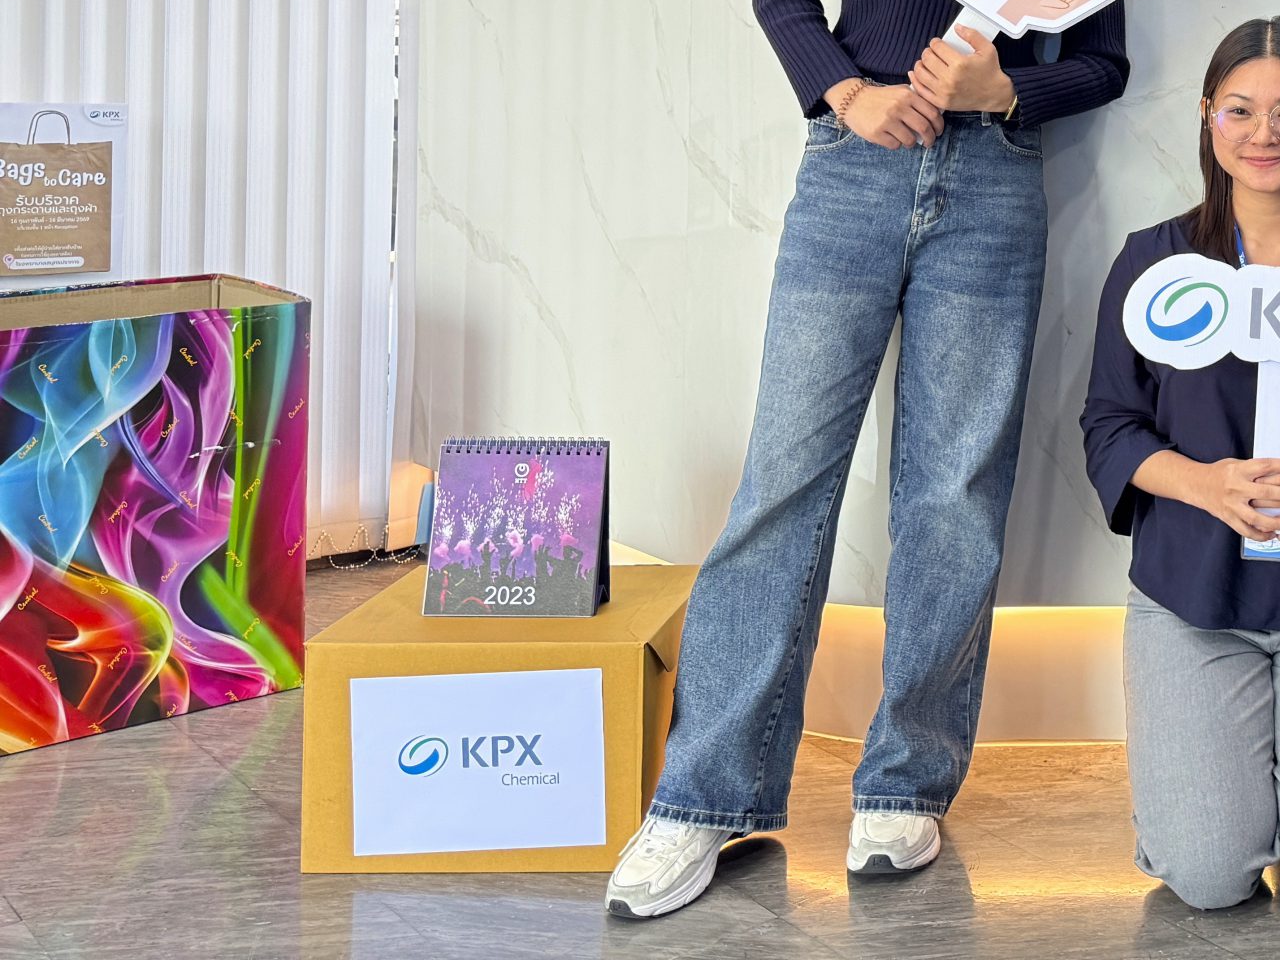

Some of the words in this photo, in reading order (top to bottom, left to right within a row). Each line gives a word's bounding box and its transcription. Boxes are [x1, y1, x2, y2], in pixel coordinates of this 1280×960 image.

[44, 176, 57, 187] to
[59, 168, 106, 187] Care
[16, 194, 79, 206] รับบริจาค
[179, 347, 198, 367] Central
[288, 398, 305, 420] Central
[287, 535, 305, 557] Central
[17, 587, 39, 611] Central
[483, 585, 536, 606] 2023
[107, 647, 128, 670] Central
[38, 664, 58, 684] Central
[461, 734, 543, 768] KPX
[501, 772, 560, 786] Chemical
